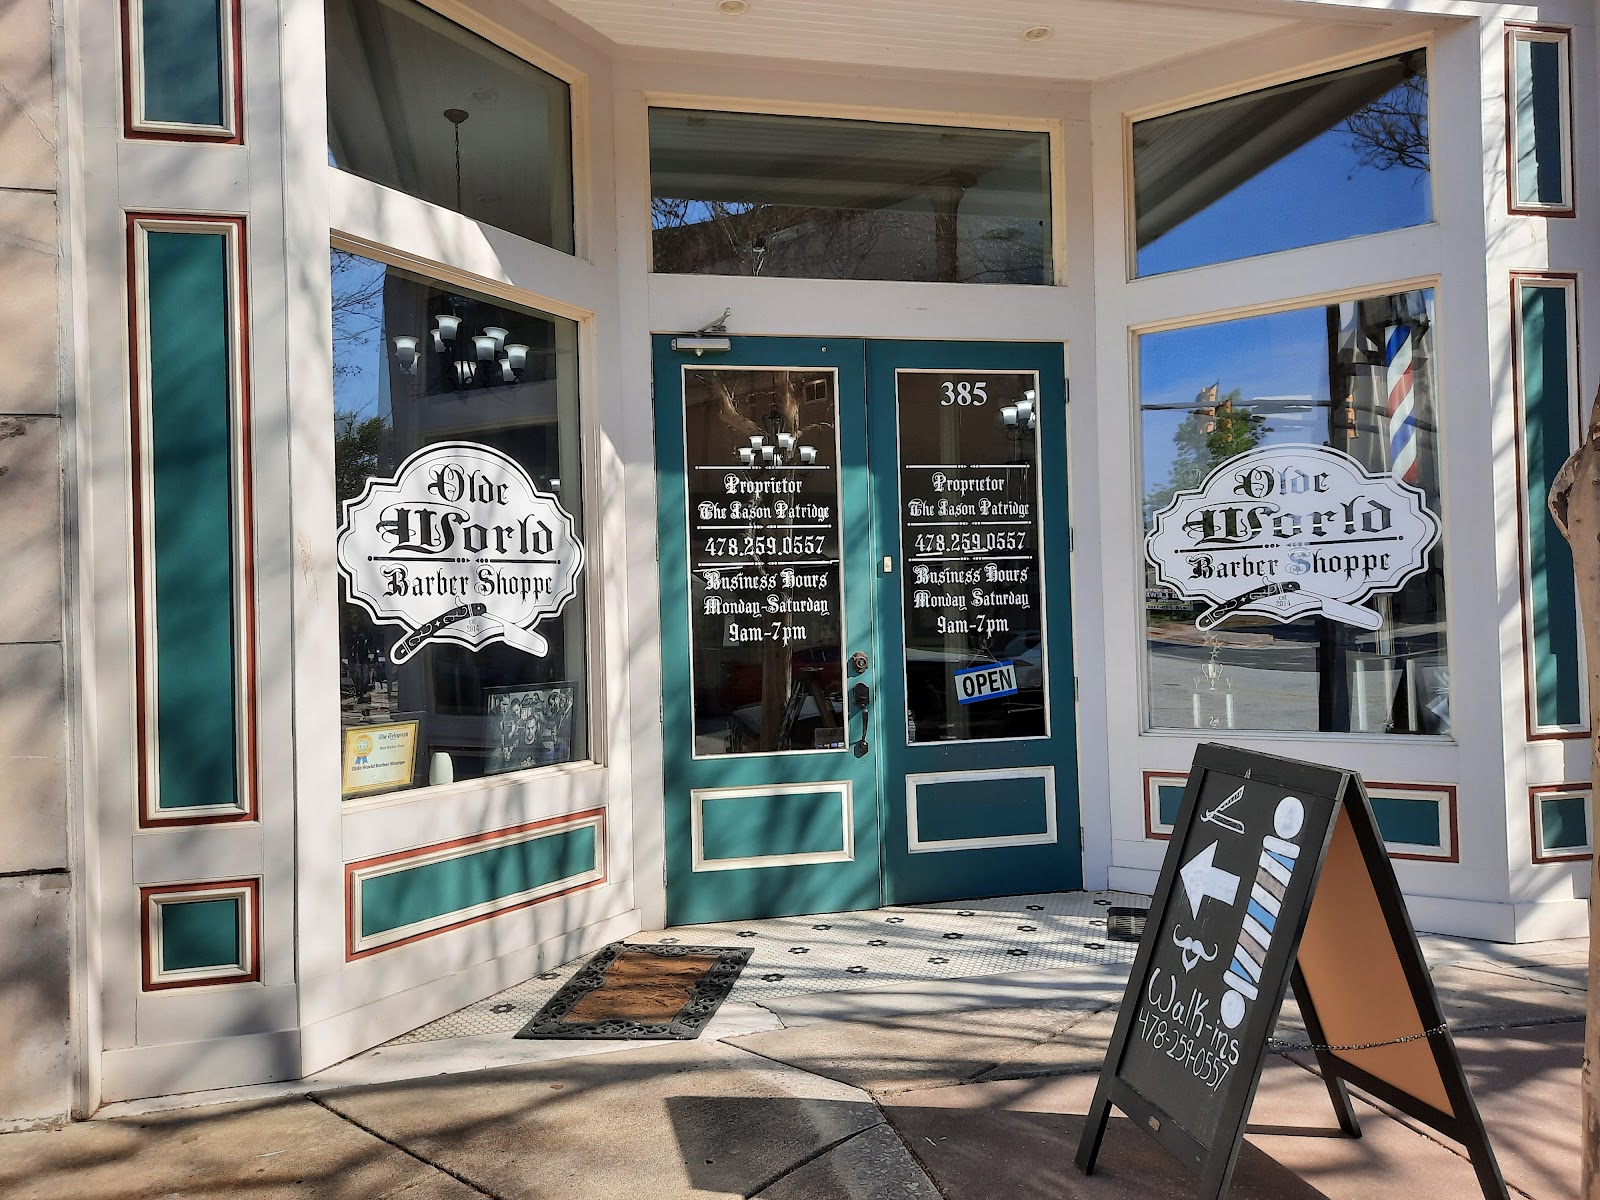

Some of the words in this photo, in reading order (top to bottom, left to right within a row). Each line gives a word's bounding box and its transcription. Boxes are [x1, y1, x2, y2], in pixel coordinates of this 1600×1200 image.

[940, 381, 988, 406] 385
[427, 463, 509, 506] Olde
[723, 473, 803, 500] Proprietor
[931, 472, 1005, 497] Proprietor
[1233, 464, 1331, 498] Olde
[697, 500, 727, 520] The
[774, 499, 830, 523] Patridge
[907, 498, 935, 517] The
[978, 497, 1030, 519] Patridge
[1182, 495, 1393, 547] World
[375, 501, 554, 555] World
[914, 531, 1026, 552] 478.259.0557
[704, 535, 826, 557] 478.259.0557
[912, 564, 981, 586] Business
[983, 562, 1030, 584] Hours
[1185, 553, 1279, 581] Barber
[1285, 548, 1391, 582] Shoppe
[380, 563, 470, 597] Barber
[474, 564, 553, 605] Shoppe
[702, 569, 778, 592] Business
[780, 567, 829, 590] Hours
[728, 621, 808, 648] 9am-7pm
[936, 614, 1010, 640] 9am-7pm
[962, 668, 1013, 698] OPEN
[1148, 967, 1240, 1066] Walk-ins
[1138, 1006, 1230, 1092] 478-259-0557
